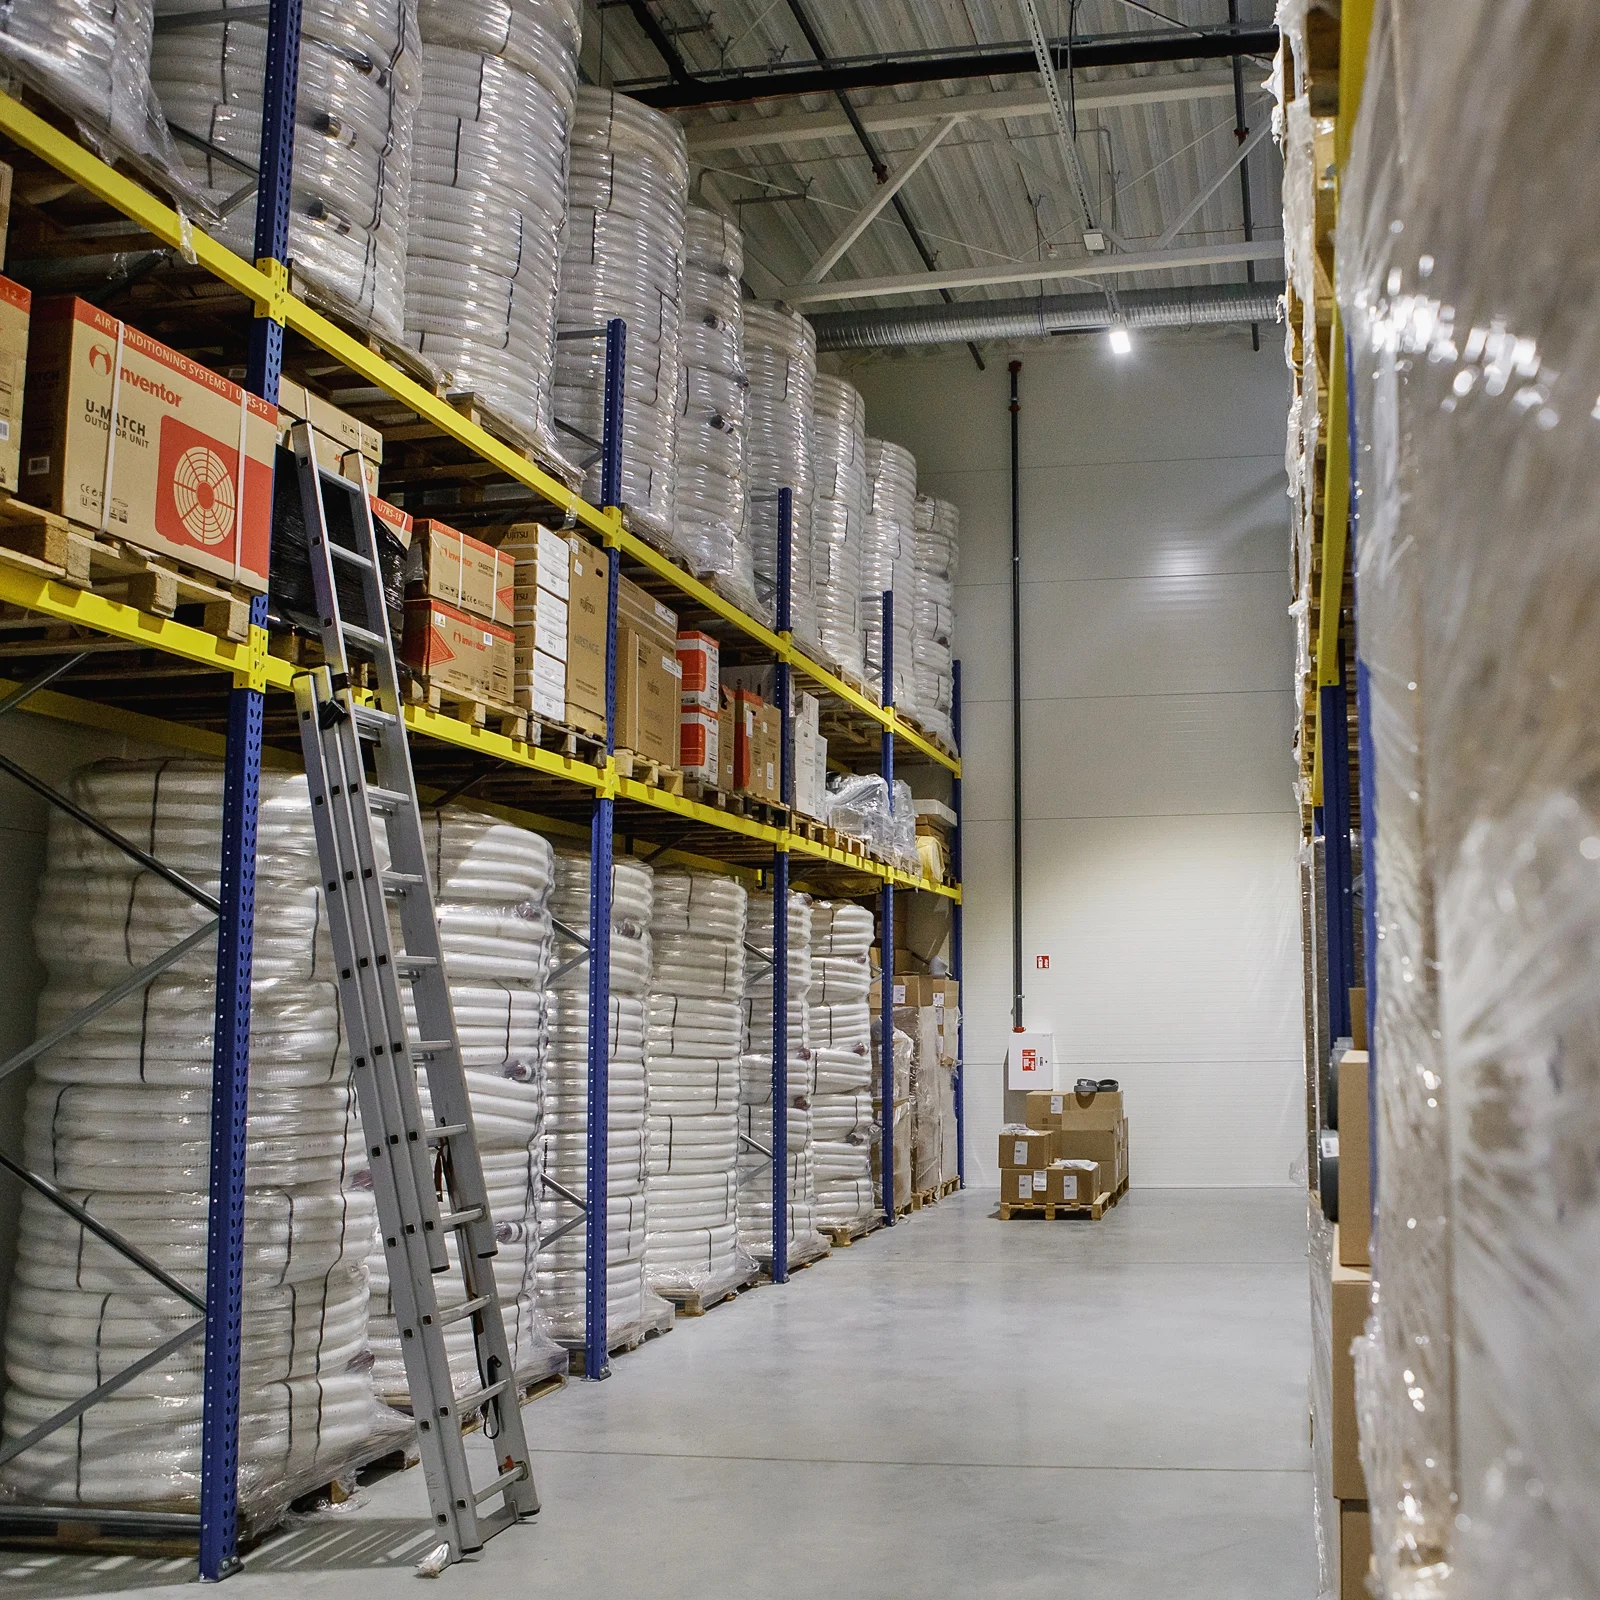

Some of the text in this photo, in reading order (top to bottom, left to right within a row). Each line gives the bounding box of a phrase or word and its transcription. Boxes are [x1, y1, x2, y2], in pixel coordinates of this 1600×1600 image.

[94, 313, 111, 330] AIR
[189, 363, 226, 392] SYSTEMS
[236, 389, 268, 415] URS-12
[120, 366, 184, 408] nventor
[84, 414, 149, 449] OUTDOR UNIT
